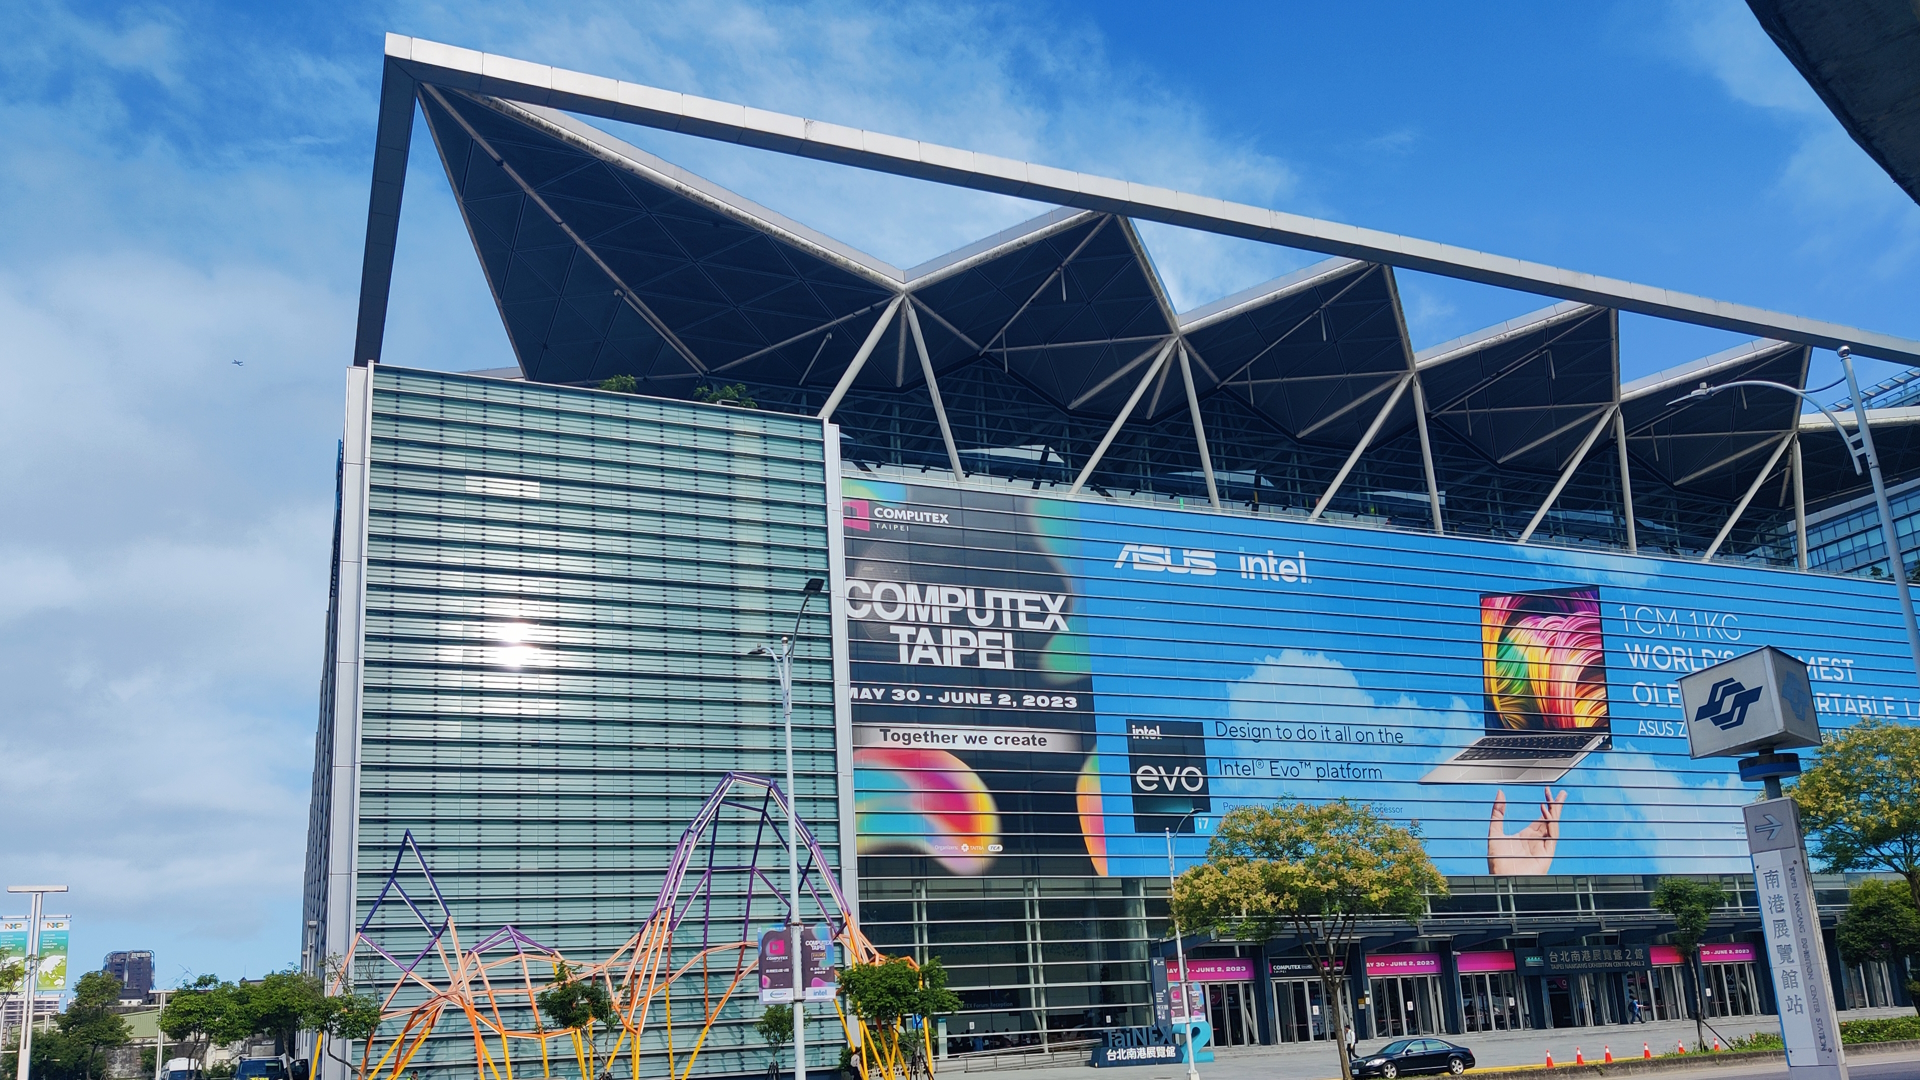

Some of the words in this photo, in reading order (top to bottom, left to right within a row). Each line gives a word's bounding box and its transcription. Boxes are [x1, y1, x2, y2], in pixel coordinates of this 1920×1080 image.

[874, 507, 950, 525] COMPUTEX
[875, 522, 910, 532] TAIPEI
[1114, 543, 1217, 575] ASUS
[1238, 546, 1311, 584] intel
[845, 579, 1069, 632] COMPUTEX
[890, 625, 1014, 669] TAIPEI
[1792, 654, 1854, 682] MEST
[850, 687, 886, 700] MAY
[891, 689, 921, 702] 30
[937, 691, 993, 705] JUNE
[998, 693, 1018, 708] 2,
[1022, 694, 1078, 709] 2023
[1632, 681, 1682, 708] OLE
[879, 728, 959, 746] Together
[963, 733, 988, 744] we
[993, 733, 1048, 747] create
[1131, 724, 1162, 740] intel
[1215, 721, 1271, 743] Design
[1276, 725, 1293, 740] to
[1296, 726, 1317, 741] do
[1320, 726, 1332, 741] it
[1334, 727, 1352, 742] all
[1355, 732, 1376, 743] on
[1379, 729, 1404, 744] the
[1638, 720, 1675, 737] ASUS
[1136, 764, 1204, 792] evo
[1316, 762, 1383, 782] platform
[1197, 817, 1209, 830] i7
[1763, 868, 1804, 1016] 南港展覽館站
[1788, 866, 1798, 889] TAIPEI
[1793, 893, 1806, 933] NANGANG
[1800, 937, 1815, 981] EXHIBITION
[1809, 984, 1821, 1014] CENTER
[1815, 1017, 1828, 1052] STATION
[1103, 1026, 1173, 1048] TaiNEX
[1172, 1021, 1215, 1064] 2
[1106, 1046, 1176, 1061] 台北南港展覽館
